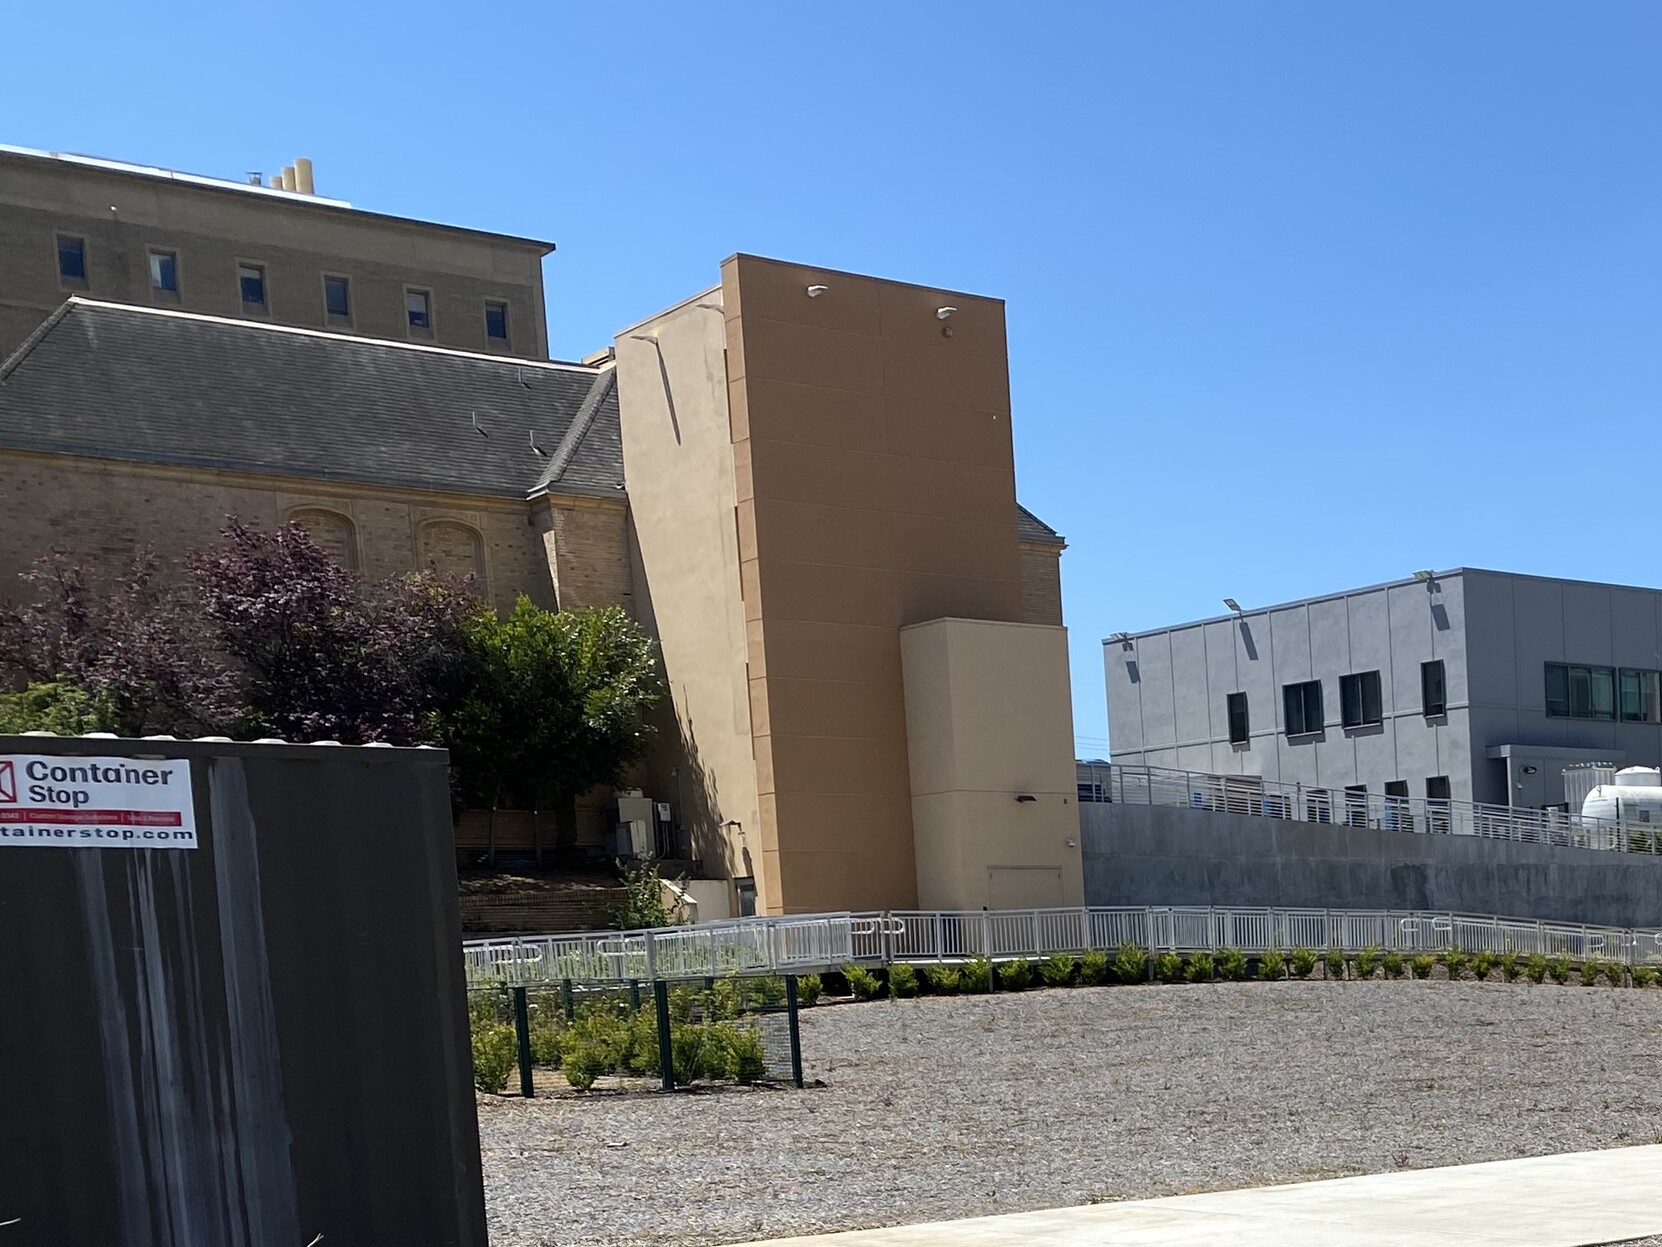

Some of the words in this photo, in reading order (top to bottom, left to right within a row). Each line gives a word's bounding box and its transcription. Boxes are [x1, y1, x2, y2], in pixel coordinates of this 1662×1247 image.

[25, 760, 173, 785] Contaner
[28, 784, 89, 808] Stop
[0, 825, 193, 840] tainerstop.com
